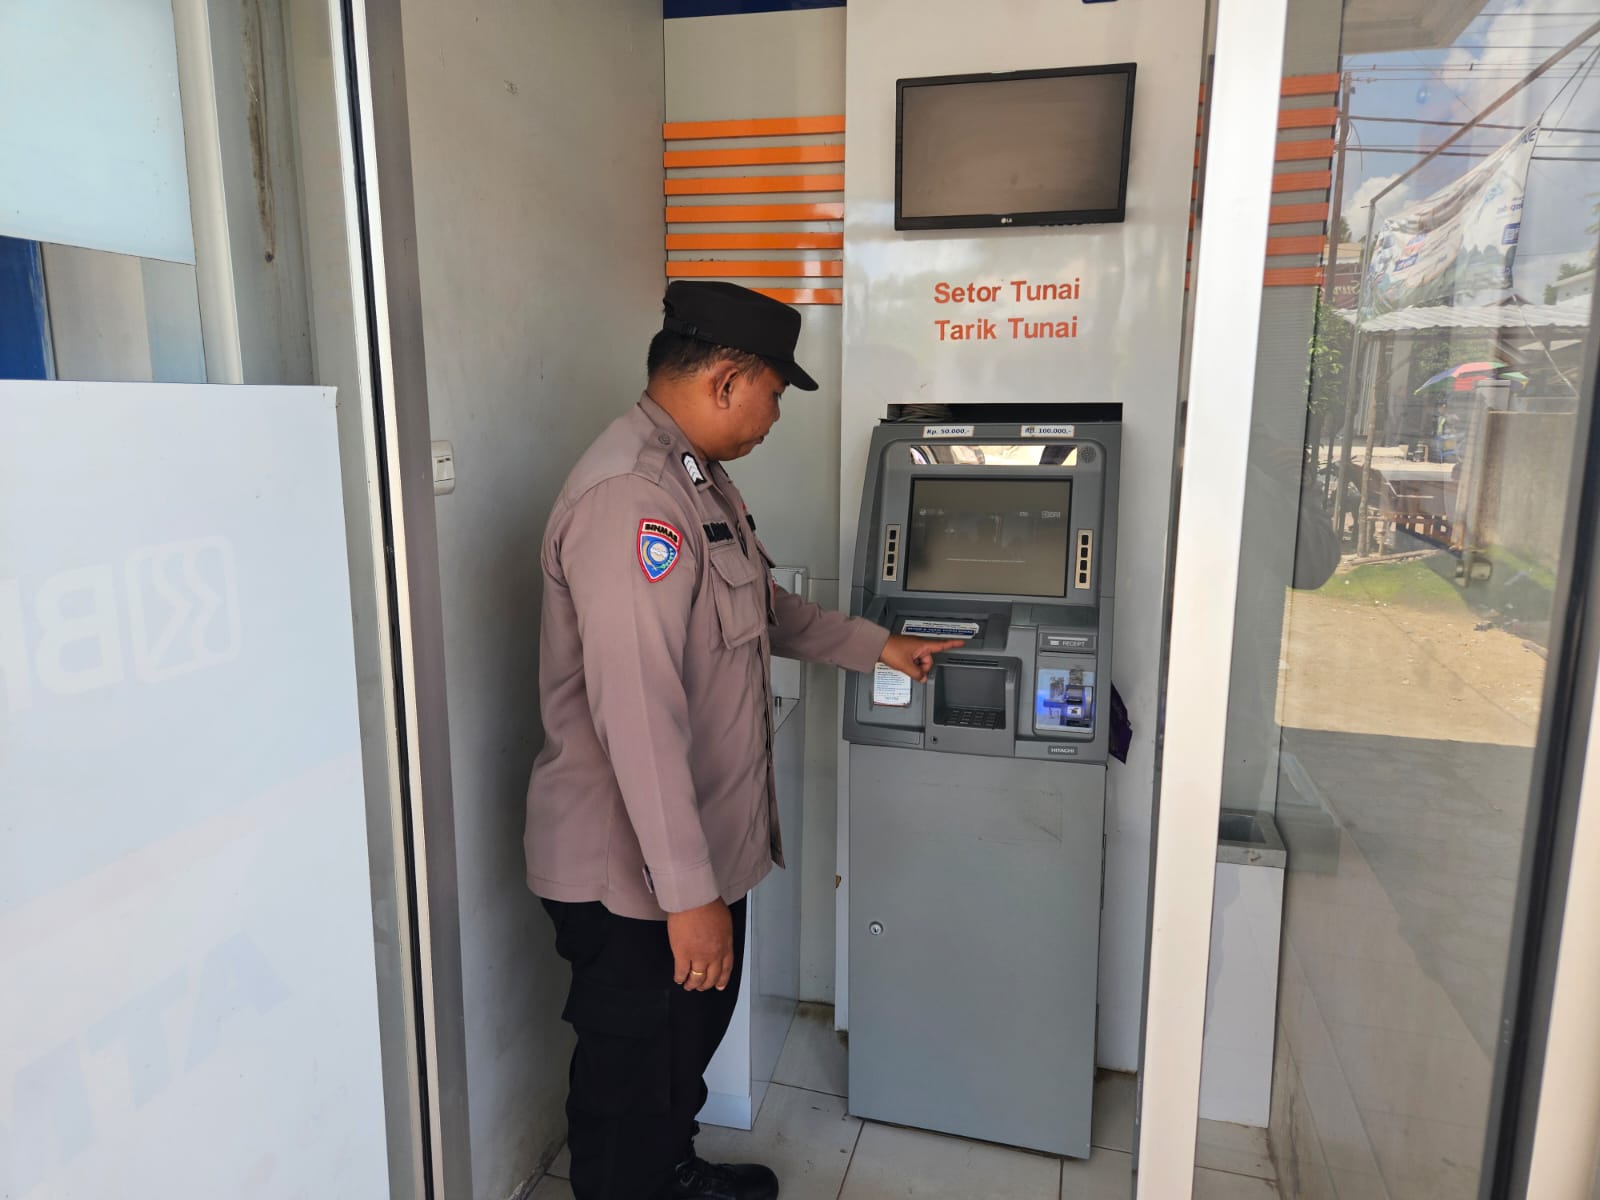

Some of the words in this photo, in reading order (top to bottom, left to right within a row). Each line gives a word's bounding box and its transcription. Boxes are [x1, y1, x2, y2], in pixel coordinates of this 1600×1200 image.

[933, 281, 1002, 304] Setor
[1010, 278, 1080, 302] Tunai
[934, 318, 997, 341] Tarik
[1007, 316, 1078, 339] Tunai
[1062, 640, 1086, 648] RECEIPT
[1050, 746, 1075, 754] HITACHI
